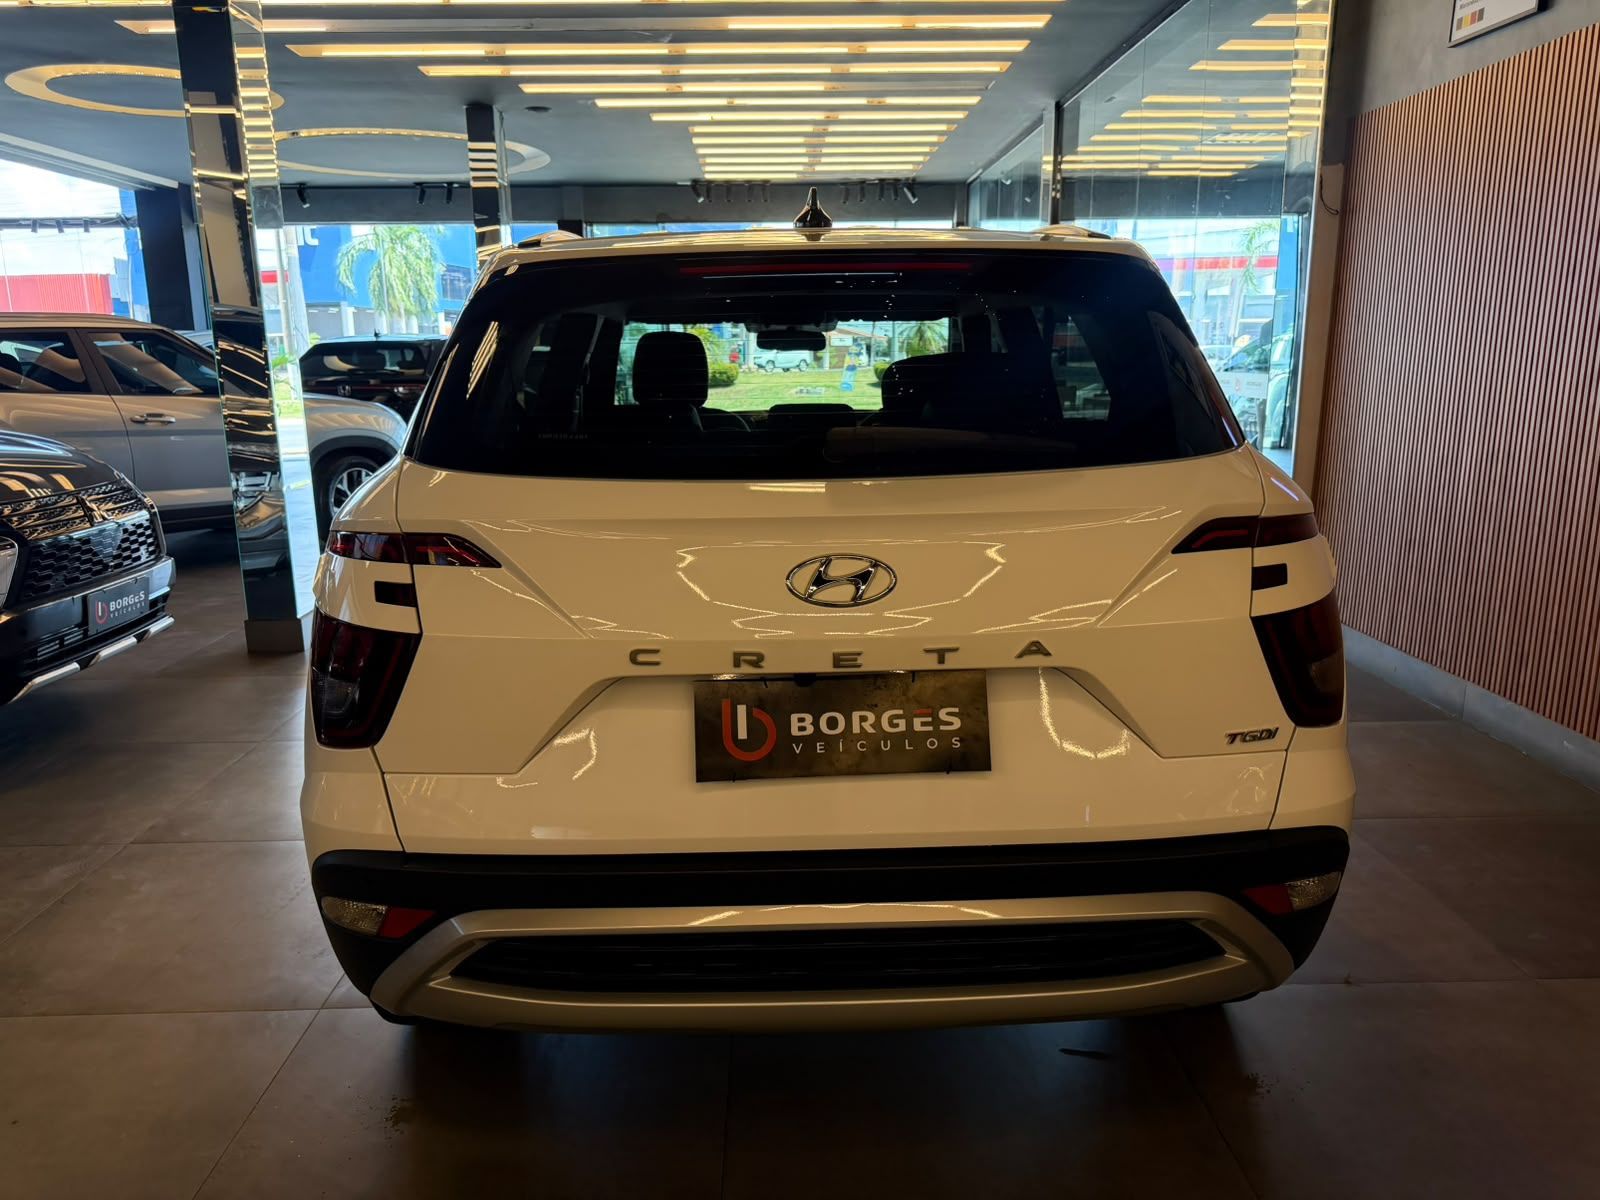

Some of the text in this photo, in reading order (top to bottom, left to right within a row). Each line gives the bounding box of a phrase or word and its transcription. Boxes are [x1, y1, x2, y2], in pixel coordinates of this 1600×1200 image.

[110, 591, 145, 611] BORGES
[629, 640, 1052, 669] CRETA
[790, 707, 962, 737] BORGES
[792, 736, 961, 754] VEÍCULOS
[1226, 727, 1279, 744] TGDI
